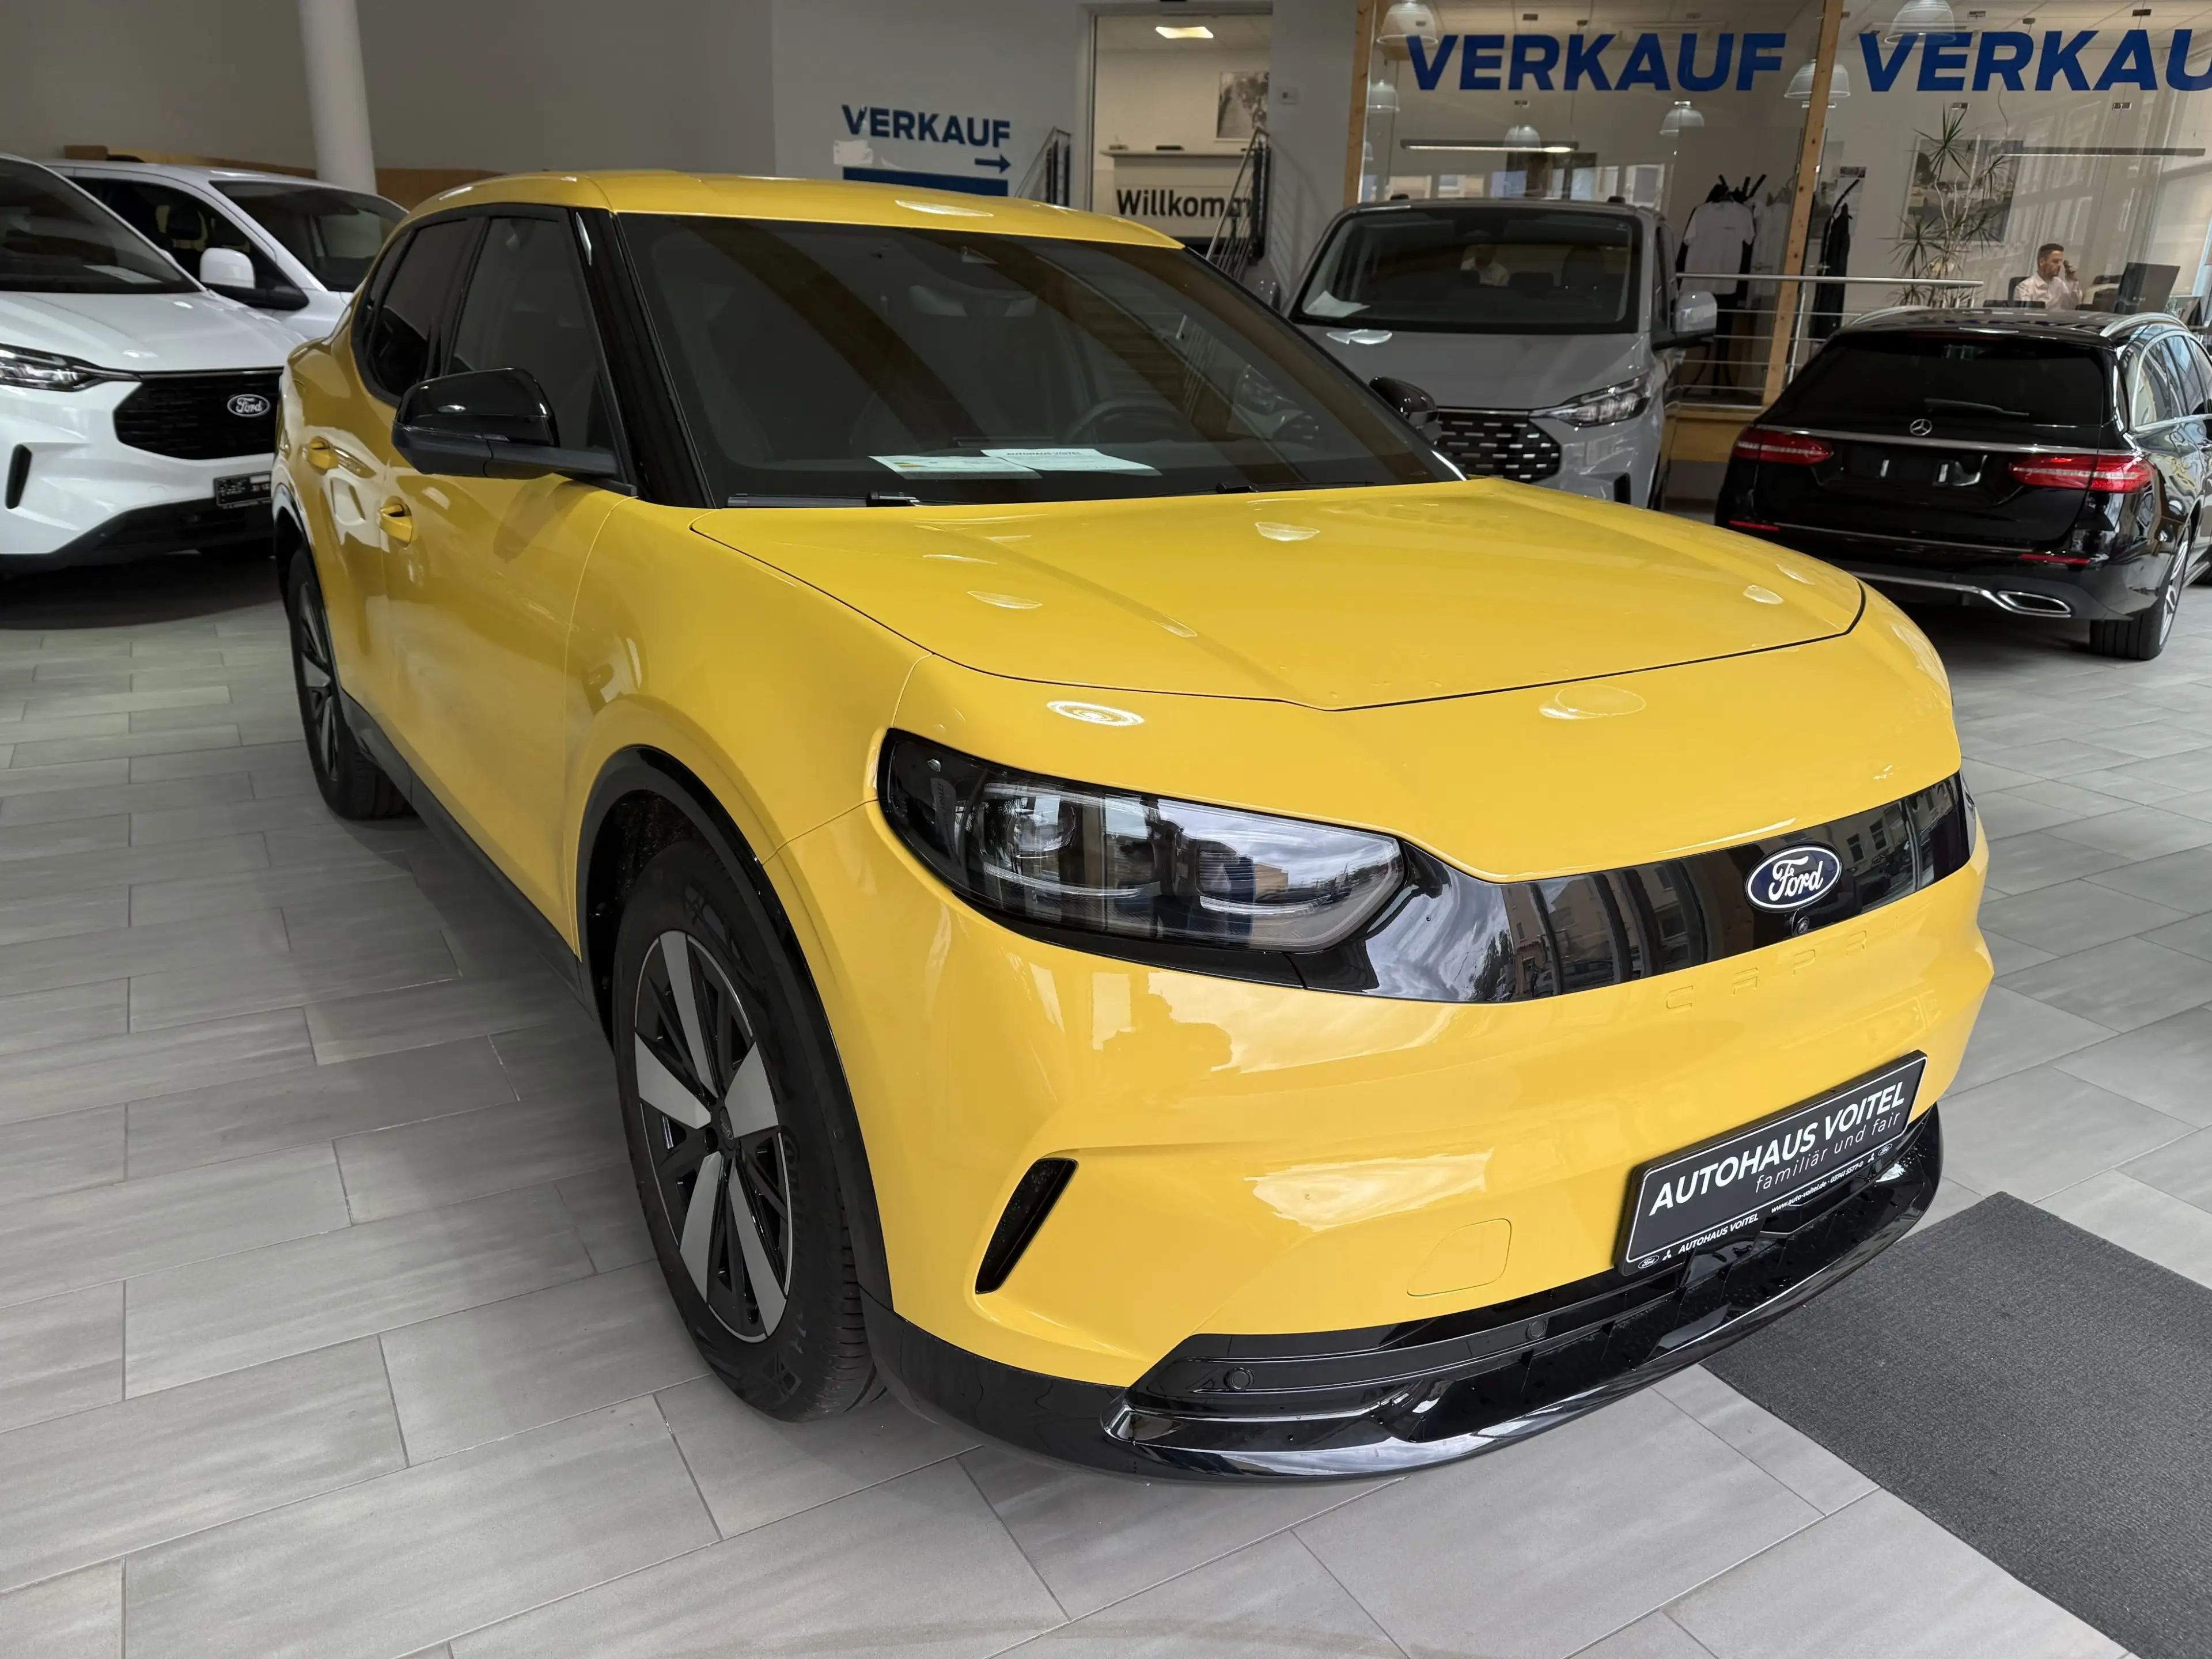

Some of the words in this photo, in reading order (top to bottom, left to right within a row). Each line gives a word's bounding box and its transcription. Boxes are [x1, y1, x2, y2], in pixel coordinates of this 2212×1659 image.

[1406, 33, 1786, 92] VERKAUF
[1858, 29, 2212, 92] VERKAU
[842, 104, 1011, 147] VERKAUF
[1768, 855, 1824, 902] Ford
[1649, 1122, 1819, 1217] AUTOHAUS
[1825, 1081, 1904, 1140] VOITEL
[1755, 1150, 1828, 1194] familiär
[1834, 1125, 1866, 1154] und
[1872, 1111, 1900, 1137] fair
[1771, 1181, 1827, 1214] www.auto-voitel.de
[1677, 1226, 1729, 1255] AUTOHAUS
[1729, 1213, 1759, 1232] VOITEL
